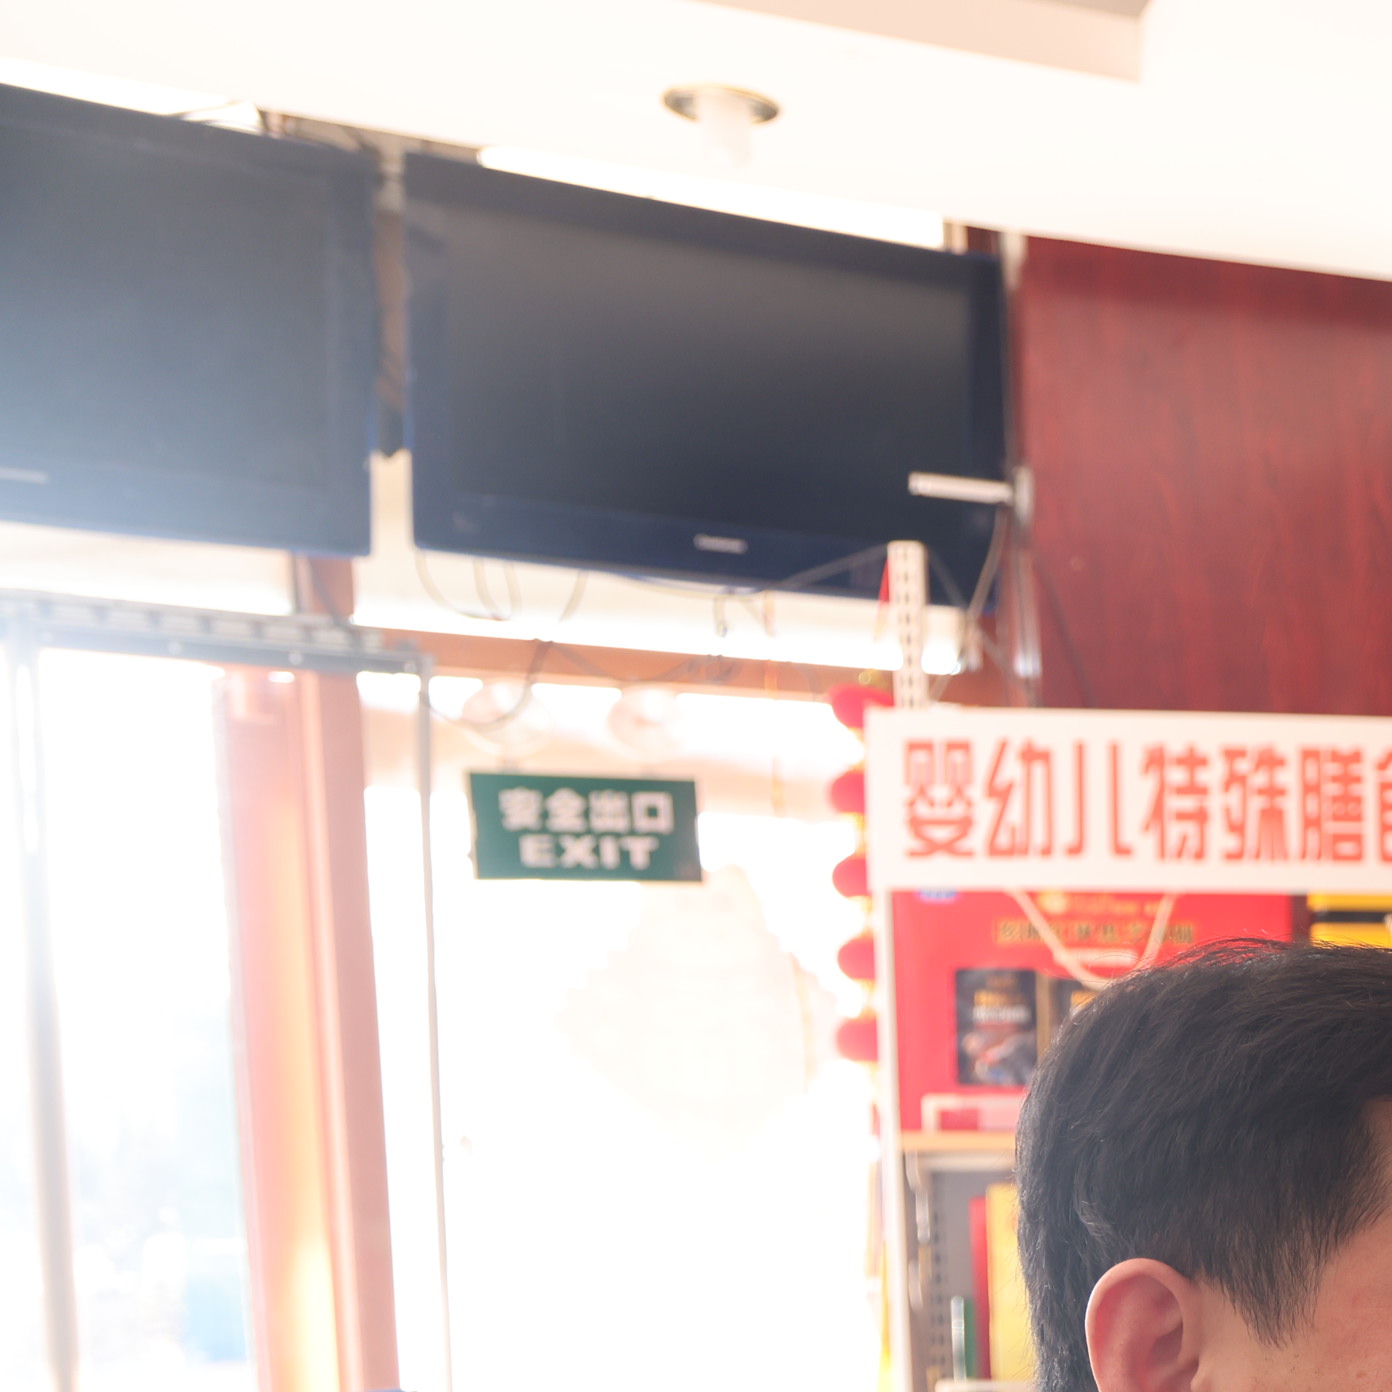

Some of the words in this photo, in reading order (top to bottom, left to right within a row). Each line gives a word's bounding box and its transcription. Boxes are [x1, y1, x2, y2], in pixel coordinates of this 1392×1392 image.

[498, 787, 675, 834] 安全出口
[518, 833, 660, 870] EXIT
